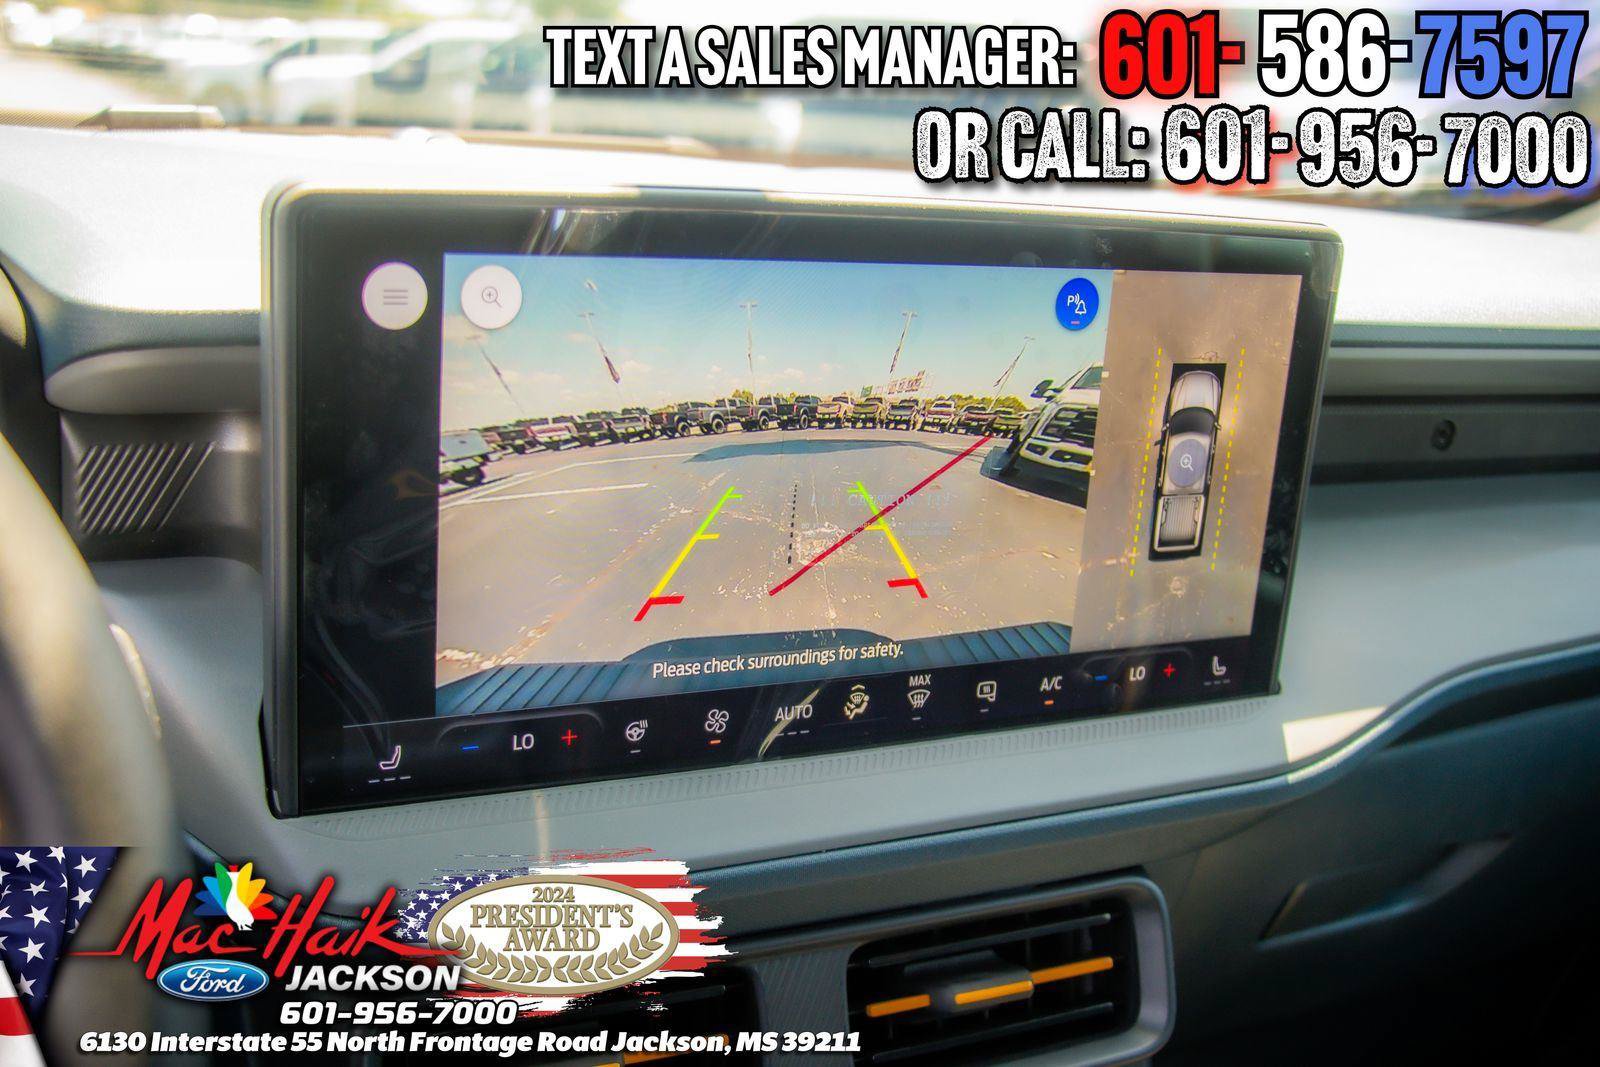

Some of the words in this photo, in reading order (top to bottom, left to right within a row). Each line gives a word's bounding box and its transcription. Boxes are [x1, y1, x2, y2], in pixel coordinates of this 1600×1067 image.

[652, 662, 701, 679] Please
[704, 655, 745, 674] check
[748, 648, 836, 670] surroundings
[838, 644, 859, 661] for
[860, 641, 904, 660] safety.
[909, 674, 931, 688] MAX
[1129, 666, 1147, 682] LO
[1039, 675, 1063, 694] A/C
[775, 703, 814, 723] AUTO
[512, 732, 535, 752] LO
